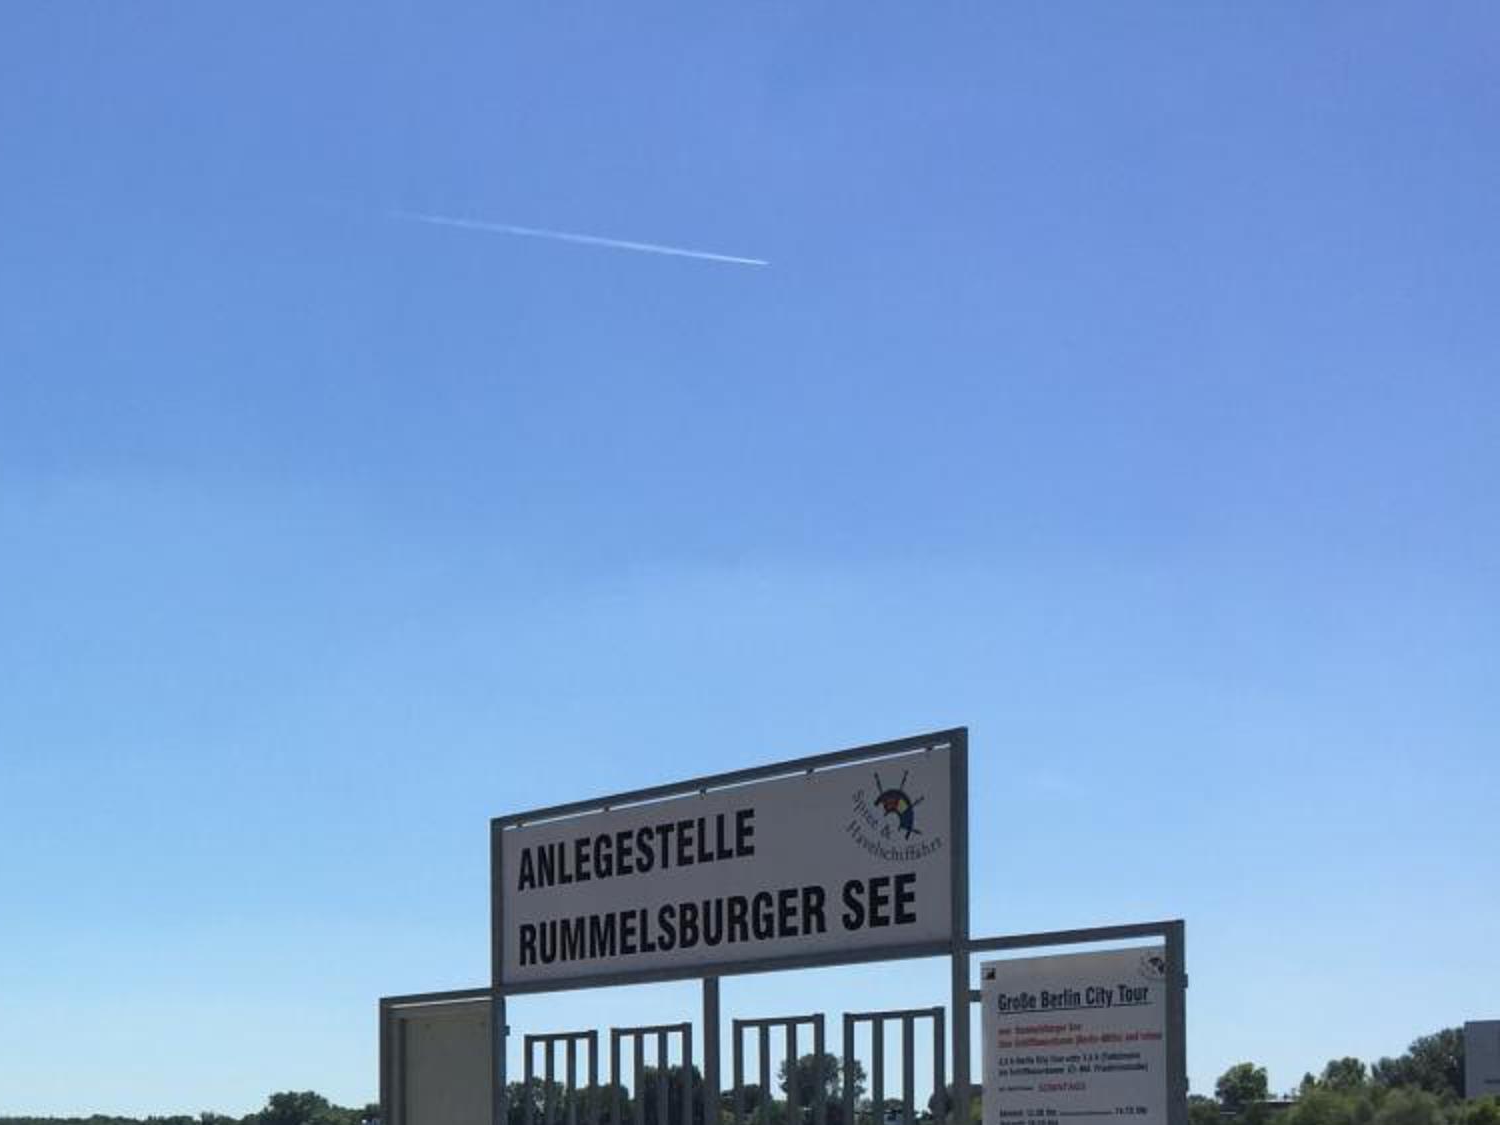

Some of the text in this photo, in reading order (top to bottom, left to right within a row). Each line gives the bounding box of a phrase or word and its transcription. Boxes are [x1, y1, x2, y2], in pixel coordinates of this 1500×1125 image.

[518, 809, 755, 891] ANLEGESTELLE
[519, 873, 917, 966] RUMMELSBURGER SEE
[998, 983, 1150, 1011] Große Berlin City Tour
